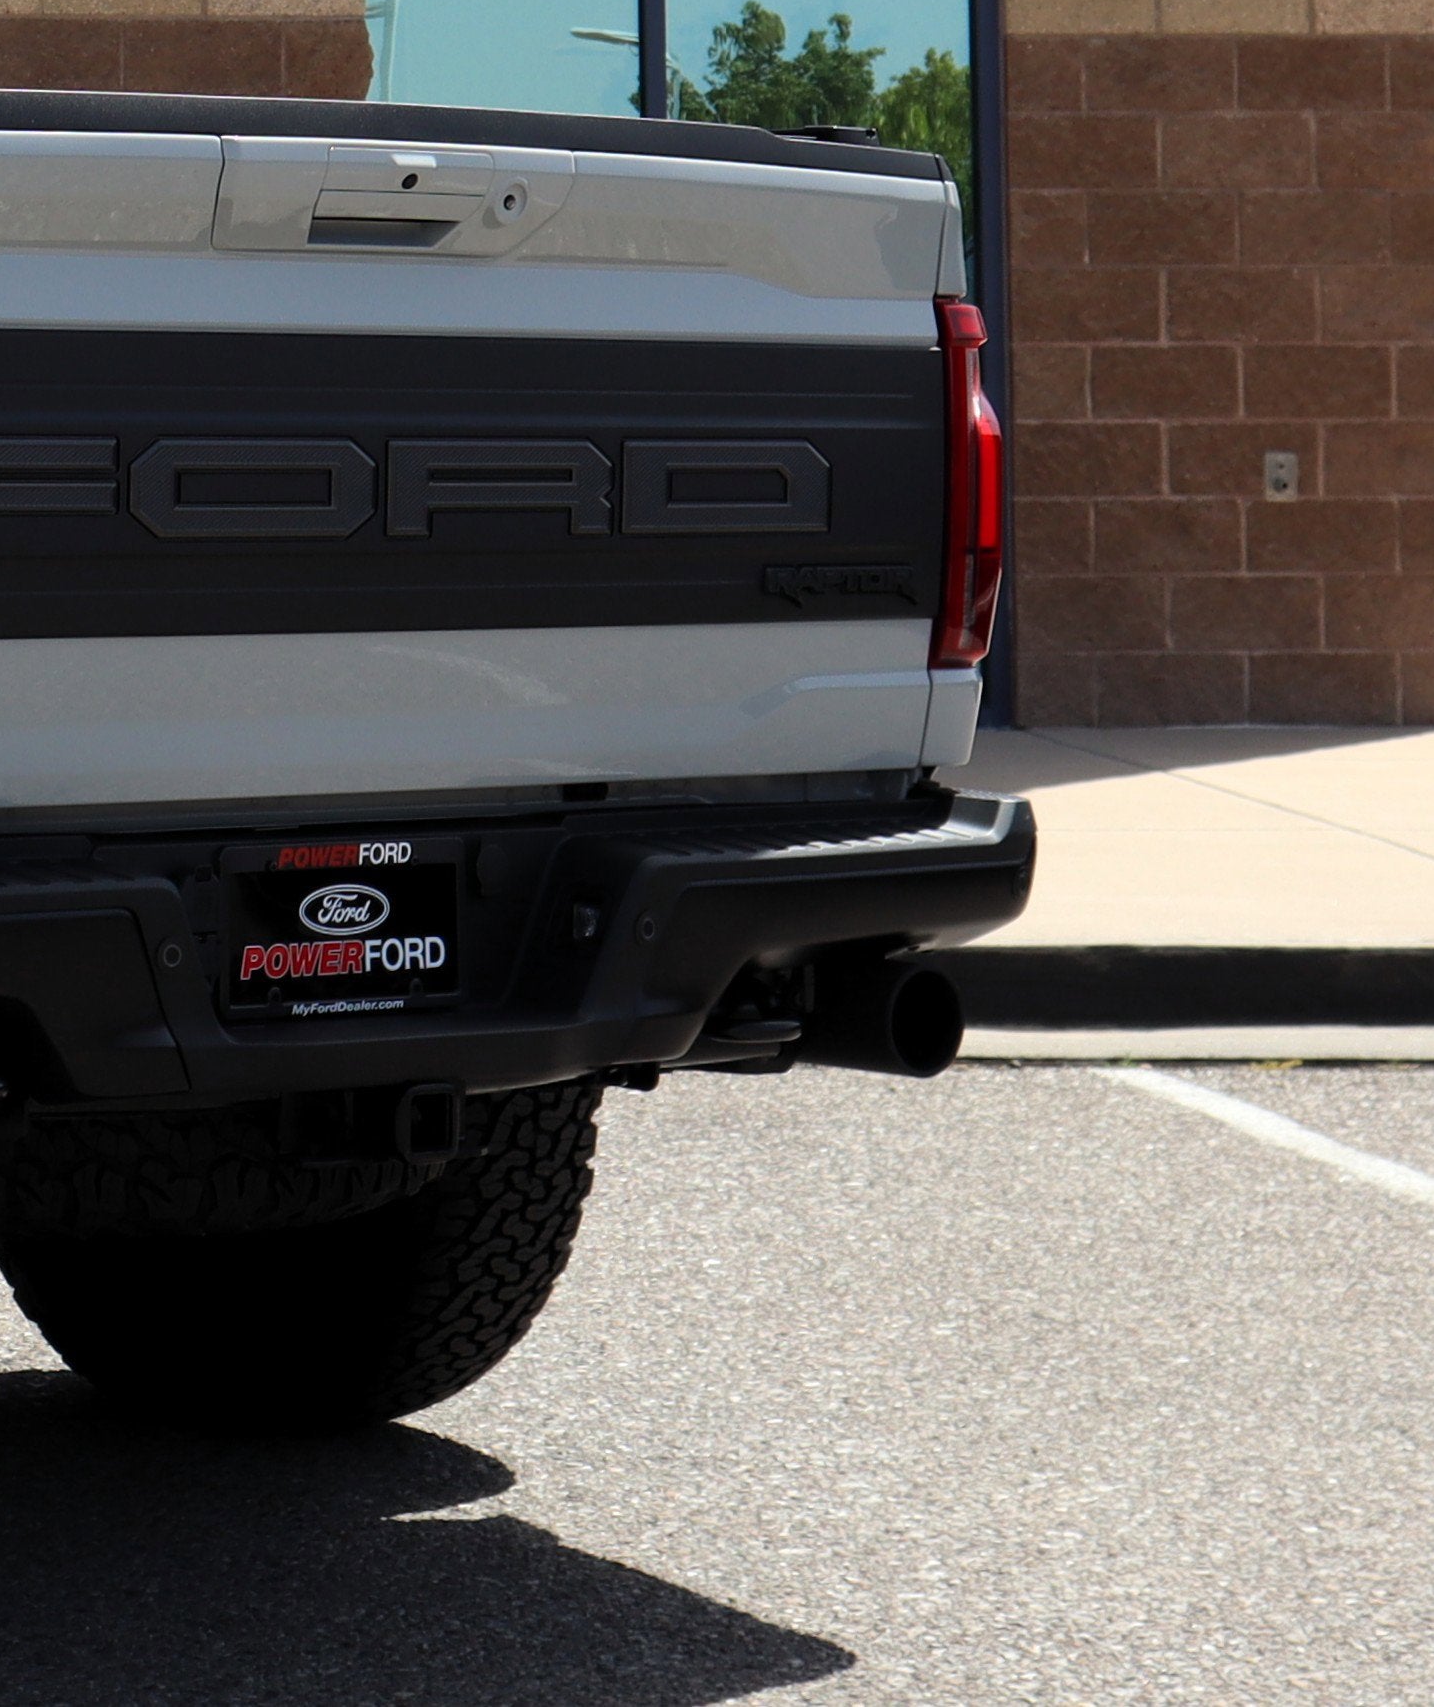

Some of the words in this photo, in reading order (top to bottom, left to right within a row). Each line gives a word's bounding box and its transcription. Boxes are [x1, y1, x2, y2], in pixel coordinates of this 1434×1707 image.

[762, 563, 918, 609] RAPTOR
[278, 841, 412, 870] POWERFORD
[318, 893, 371, 924] Ford
[240, 936, 446, 981] POWERFORD
[292, 997, 405, 1017] MyFordDealer.com
